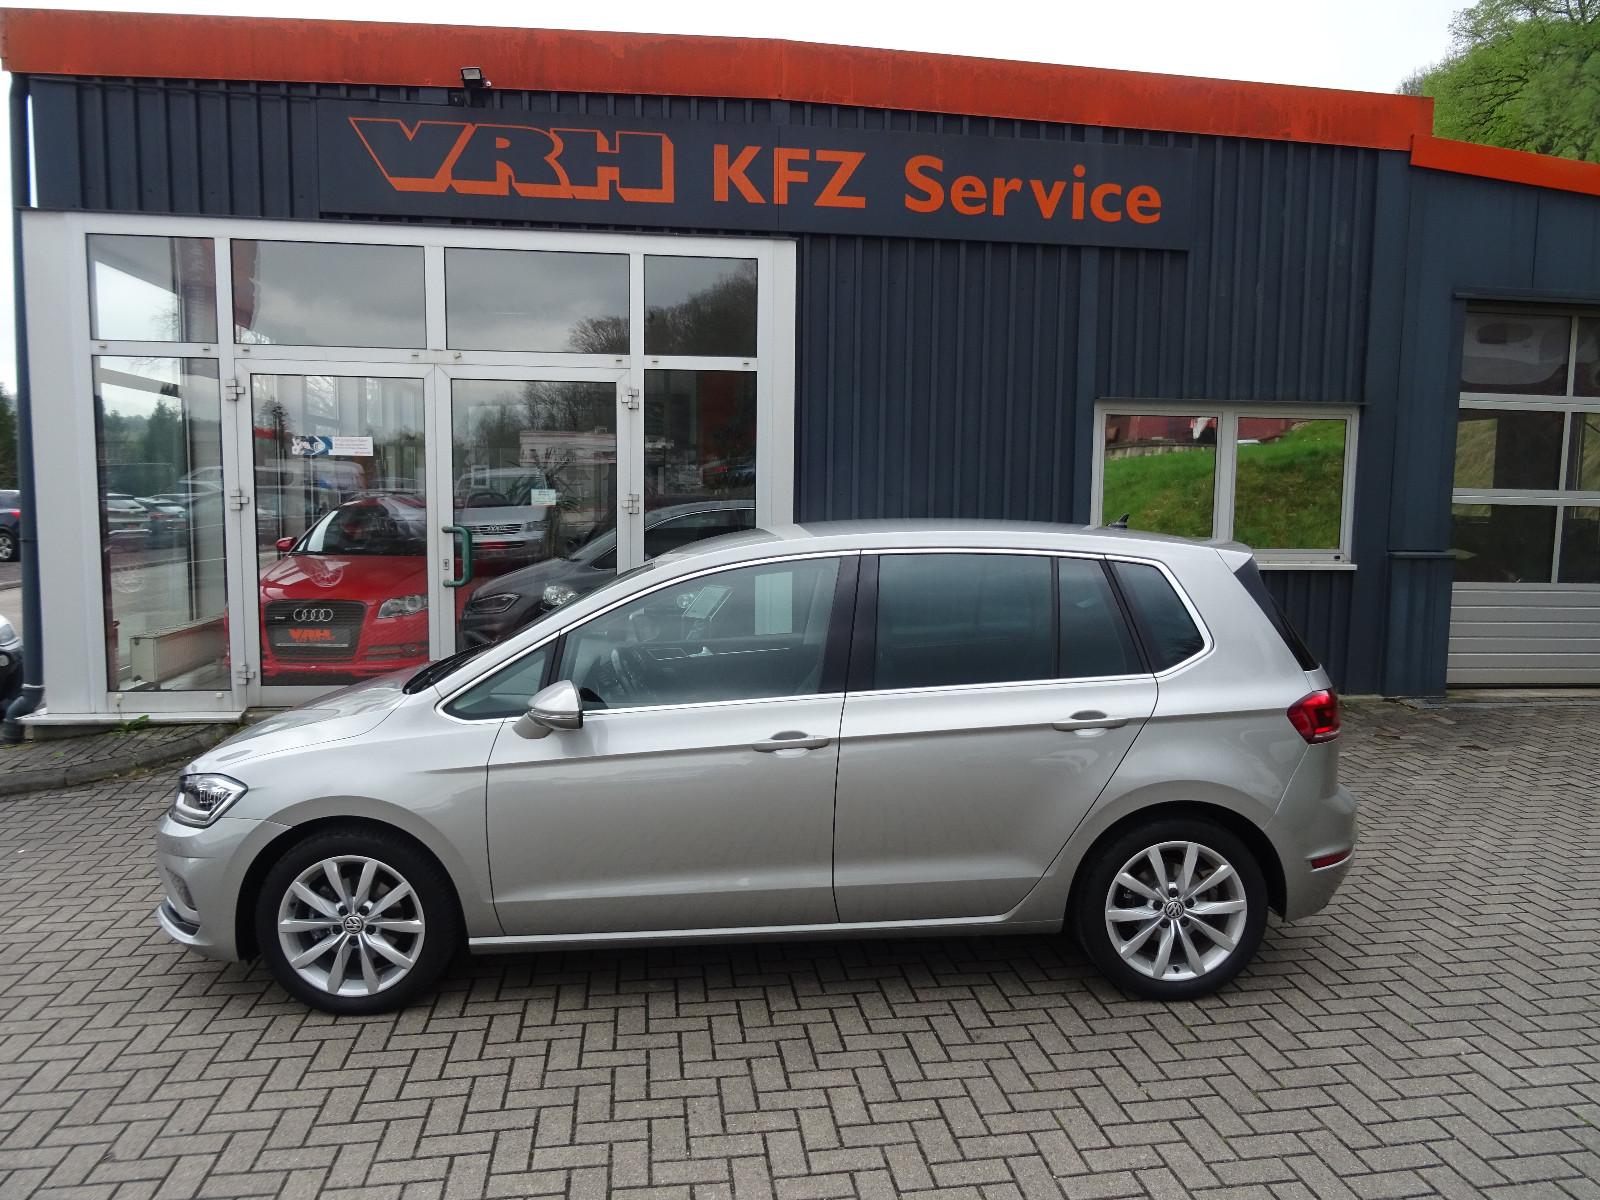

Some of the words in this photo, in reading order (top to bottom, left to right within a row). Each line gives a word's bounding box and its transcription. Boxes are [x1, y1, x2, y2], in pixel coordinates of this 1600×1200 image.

[349, 117, 675, 204] VRH
[713, 143, 867, 209] KFZ
[904, 154, 1162, 225] Service
